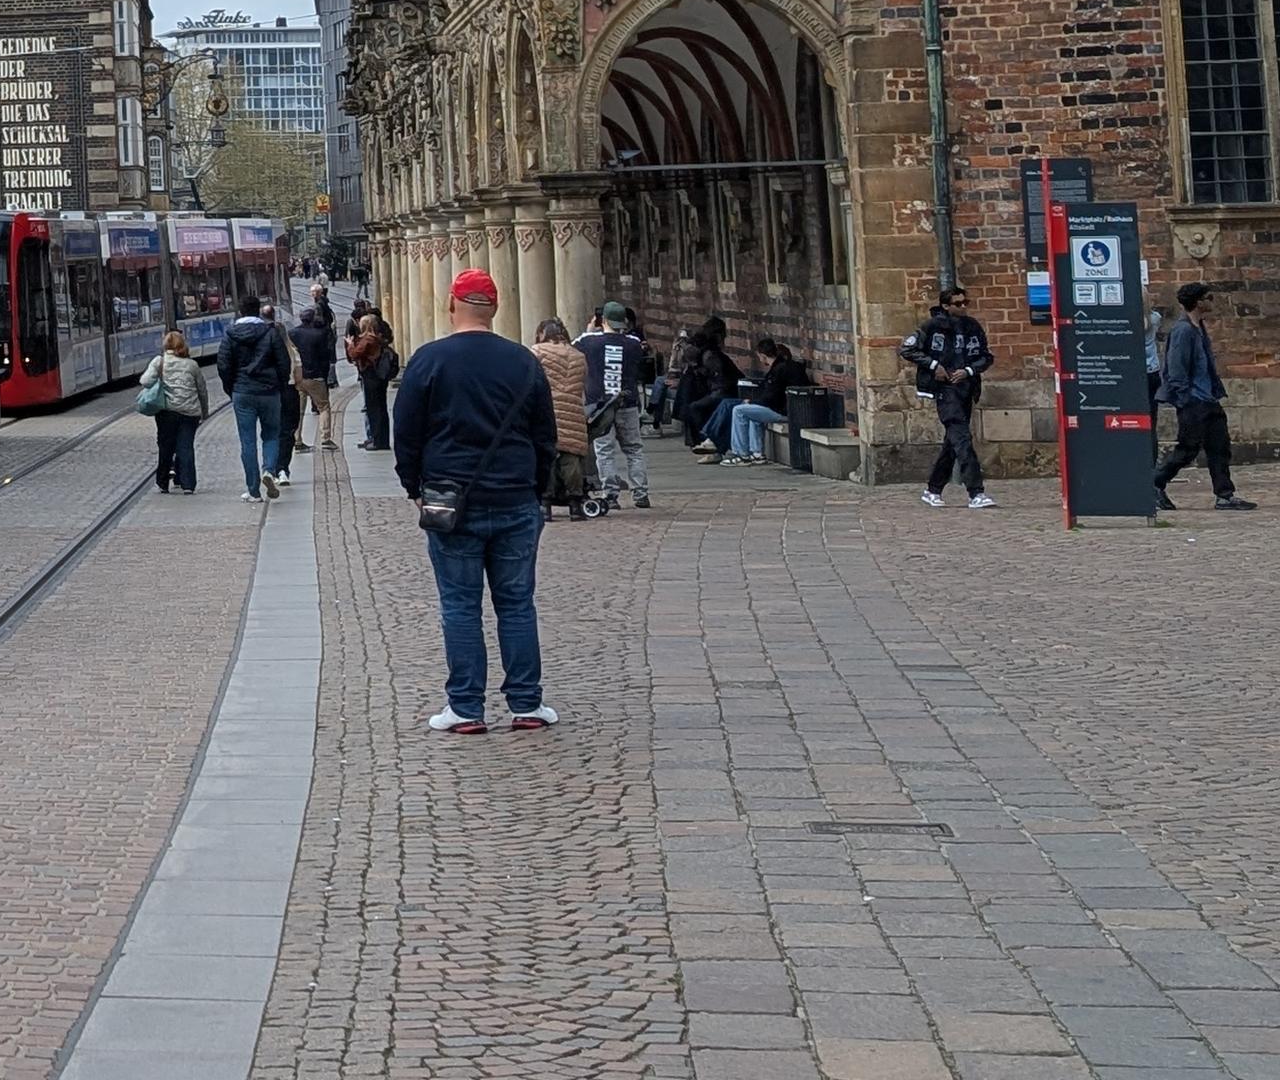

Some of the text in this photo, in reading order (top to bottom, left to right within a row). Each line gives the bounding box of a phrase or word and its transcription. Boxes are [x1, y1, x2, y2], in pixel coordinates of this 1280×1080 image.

[0, 37, 57, 56] GEDENKE
[0, 60, 25, 78] DER
[1, 80, 59, 100] BRÜDER,
[2, 103, 50, 122] DIE DAS
[2, 125, 70, 144] SCHICKSAL
[3, 148, 62, 166] UNSERER
[3, 170, 72, 188] TRENNUNG
[604, 344, 623, 395] HILFIGER
